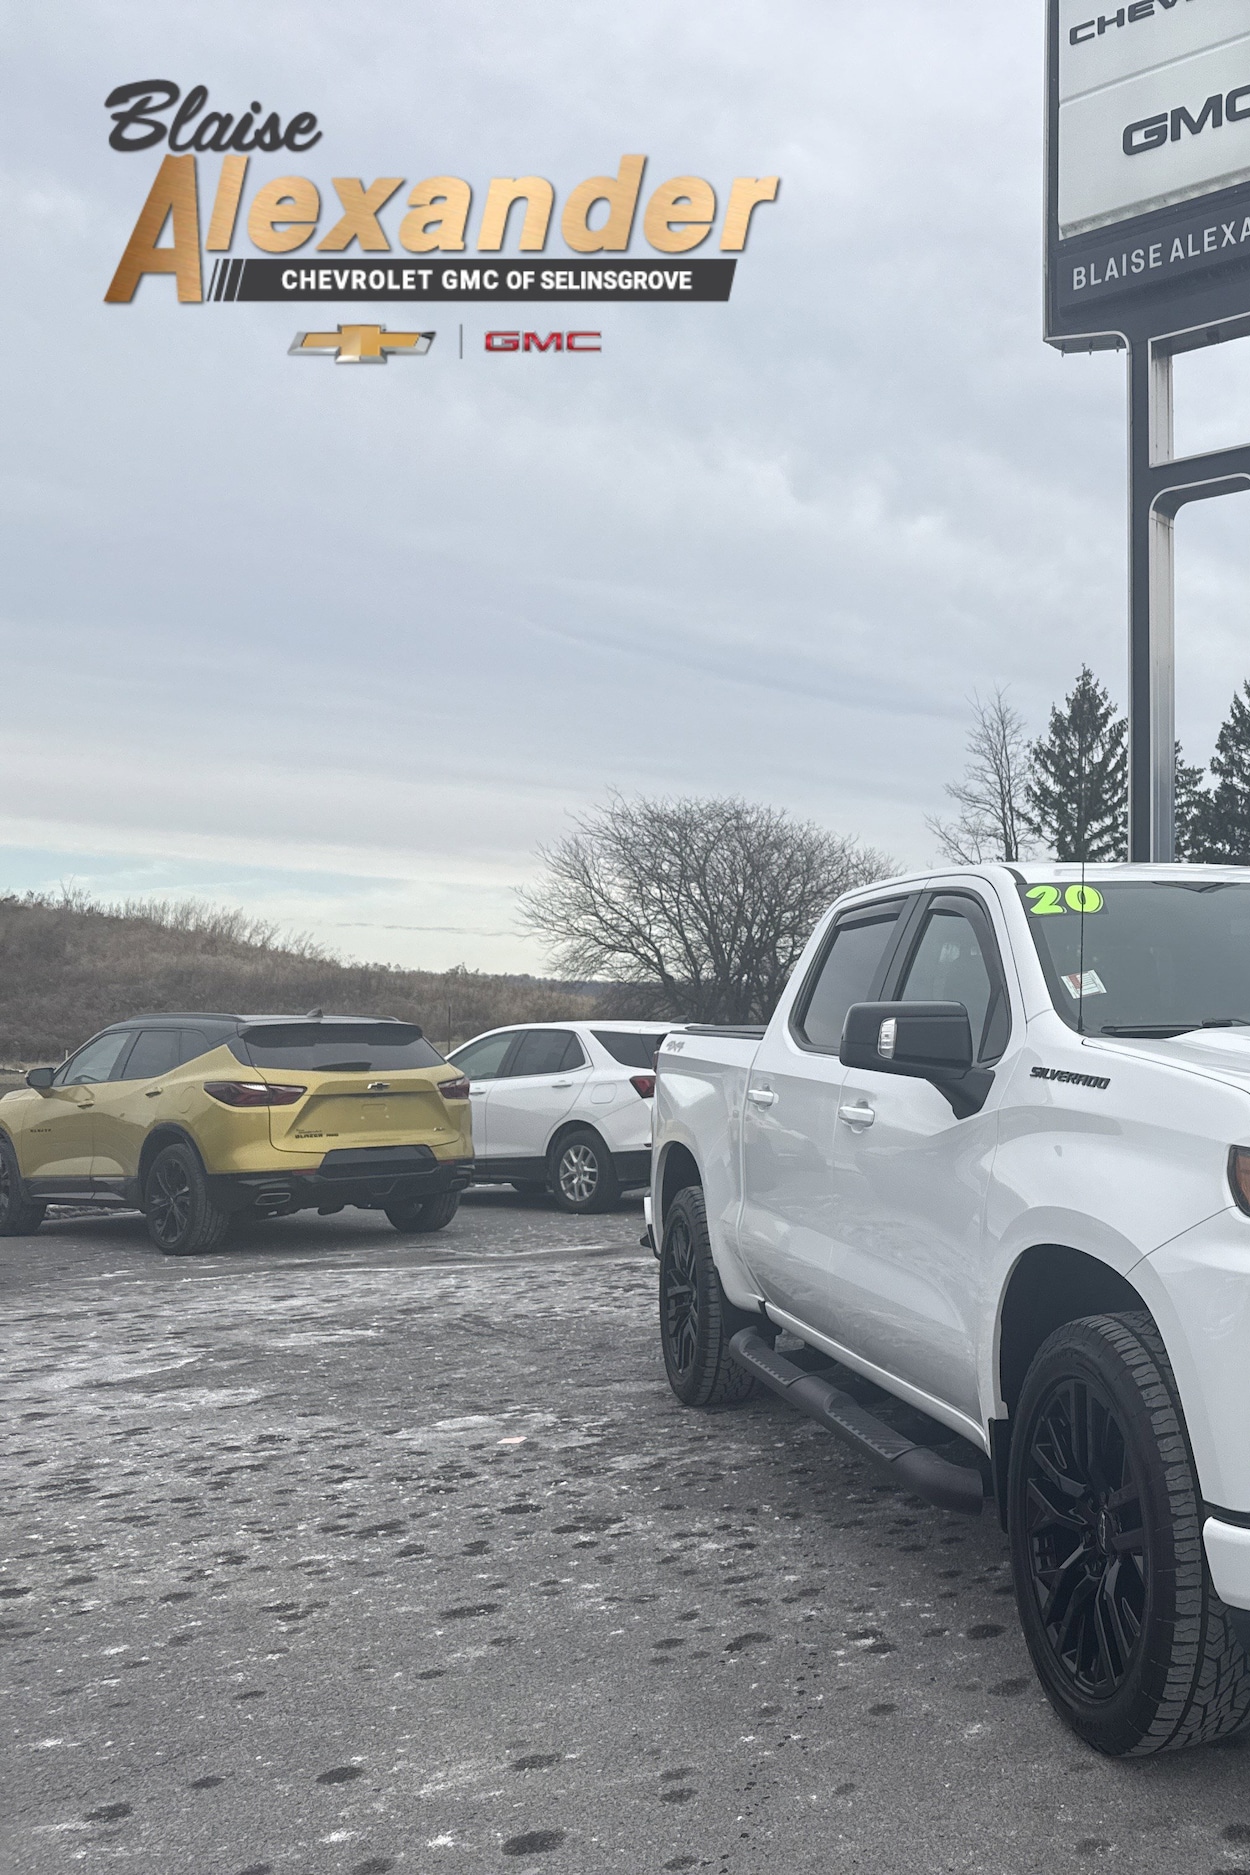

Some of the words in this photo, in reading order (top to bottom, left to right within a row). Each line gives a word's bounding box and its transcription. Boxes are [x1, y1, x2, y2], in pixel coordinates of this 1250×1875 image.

[1069, 0, 1196, 46] CHEV
[1072, 242, 1163, 291] BLAISE
[1024, 883, 1104, 916] 20
[1029, 1065, 1112, 1090] SILVERADO
